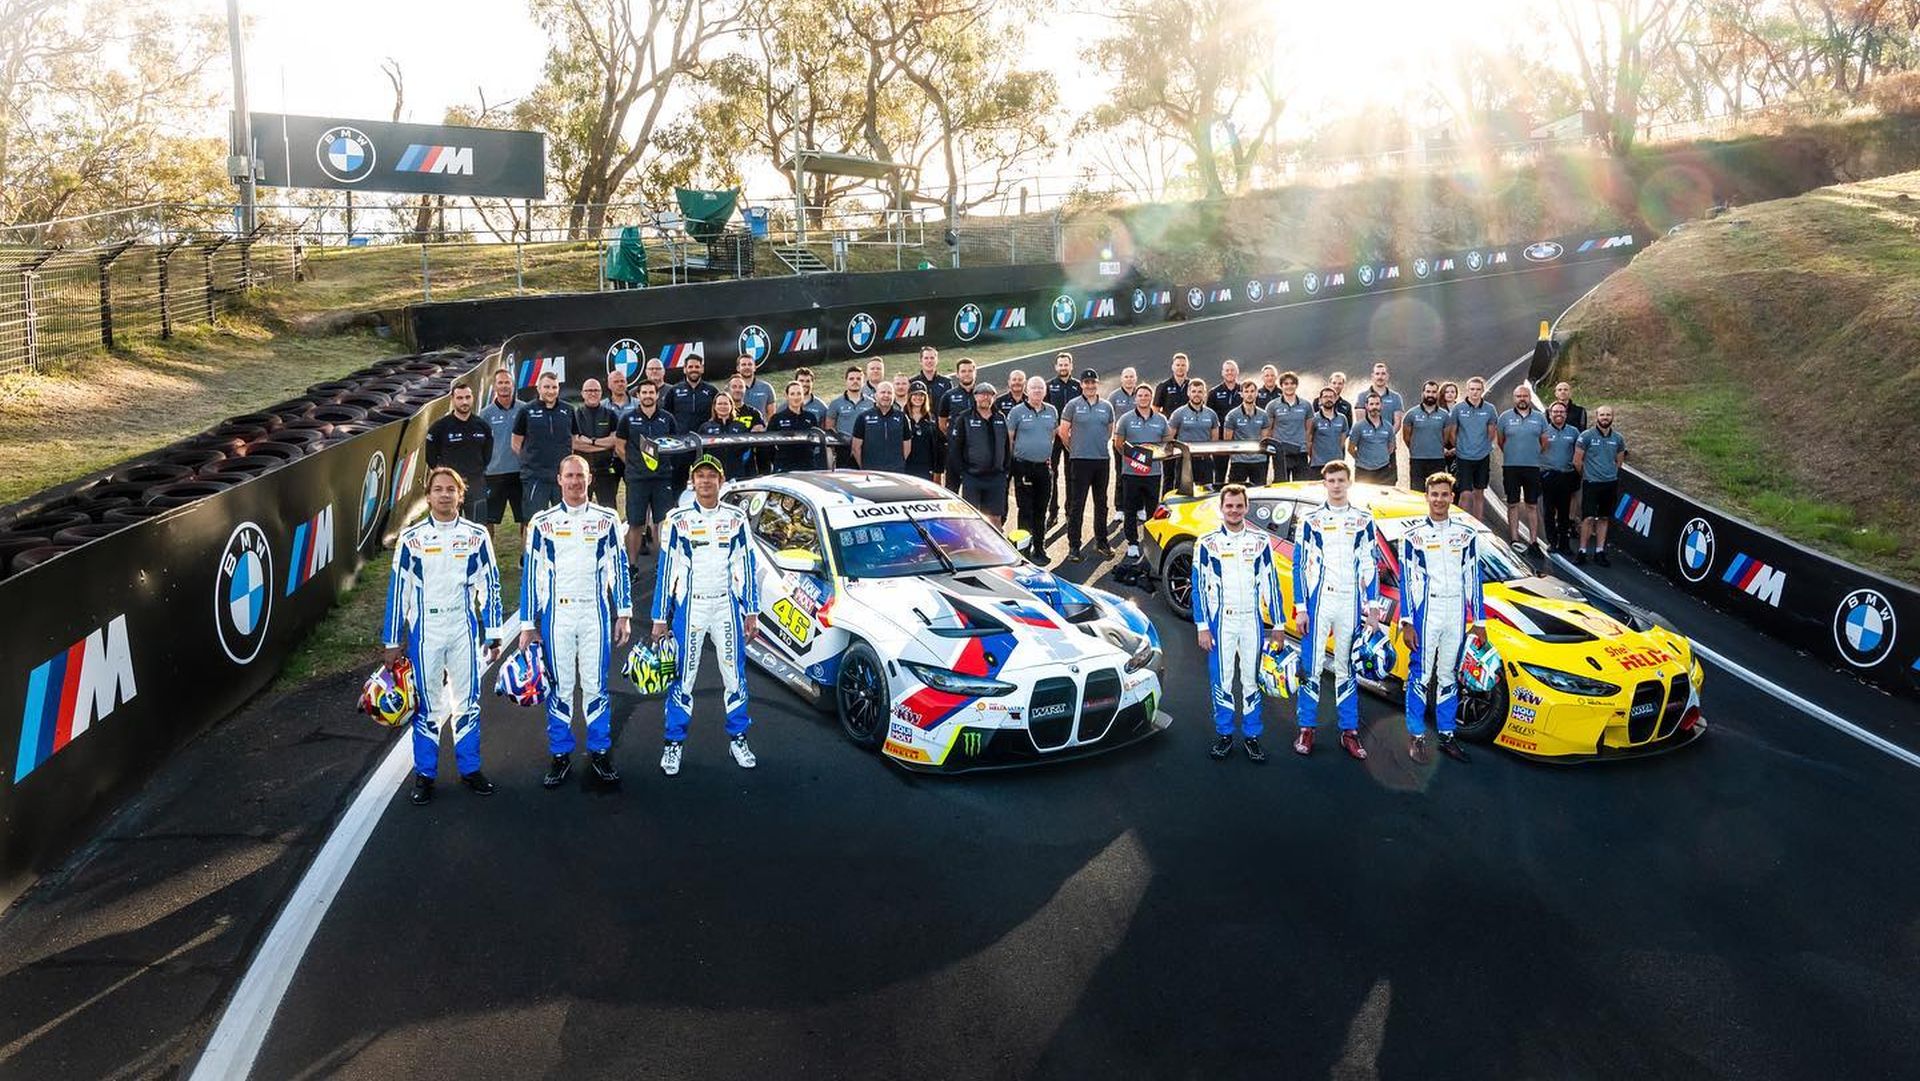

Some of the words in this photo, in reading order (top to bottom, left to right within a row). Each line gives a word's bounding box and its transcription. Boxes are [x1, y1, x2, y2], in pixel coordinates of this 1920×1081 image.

[325, 128, 369, 146] BMW
[610, 340, 643, 358] BMW
[853, 505, 900, 519] LIQUI
[902, 503, 942, 514] MOLY
[1687, 519, 1712, 544] BMW
[223, 533, 267, 577] BMW
[1847, 592, 1892, 622] BMW
[772, 597, 811, 643] 46
[1517, 692, 1544, 706] KW
[1031, 703, 1067, 718] WRT
